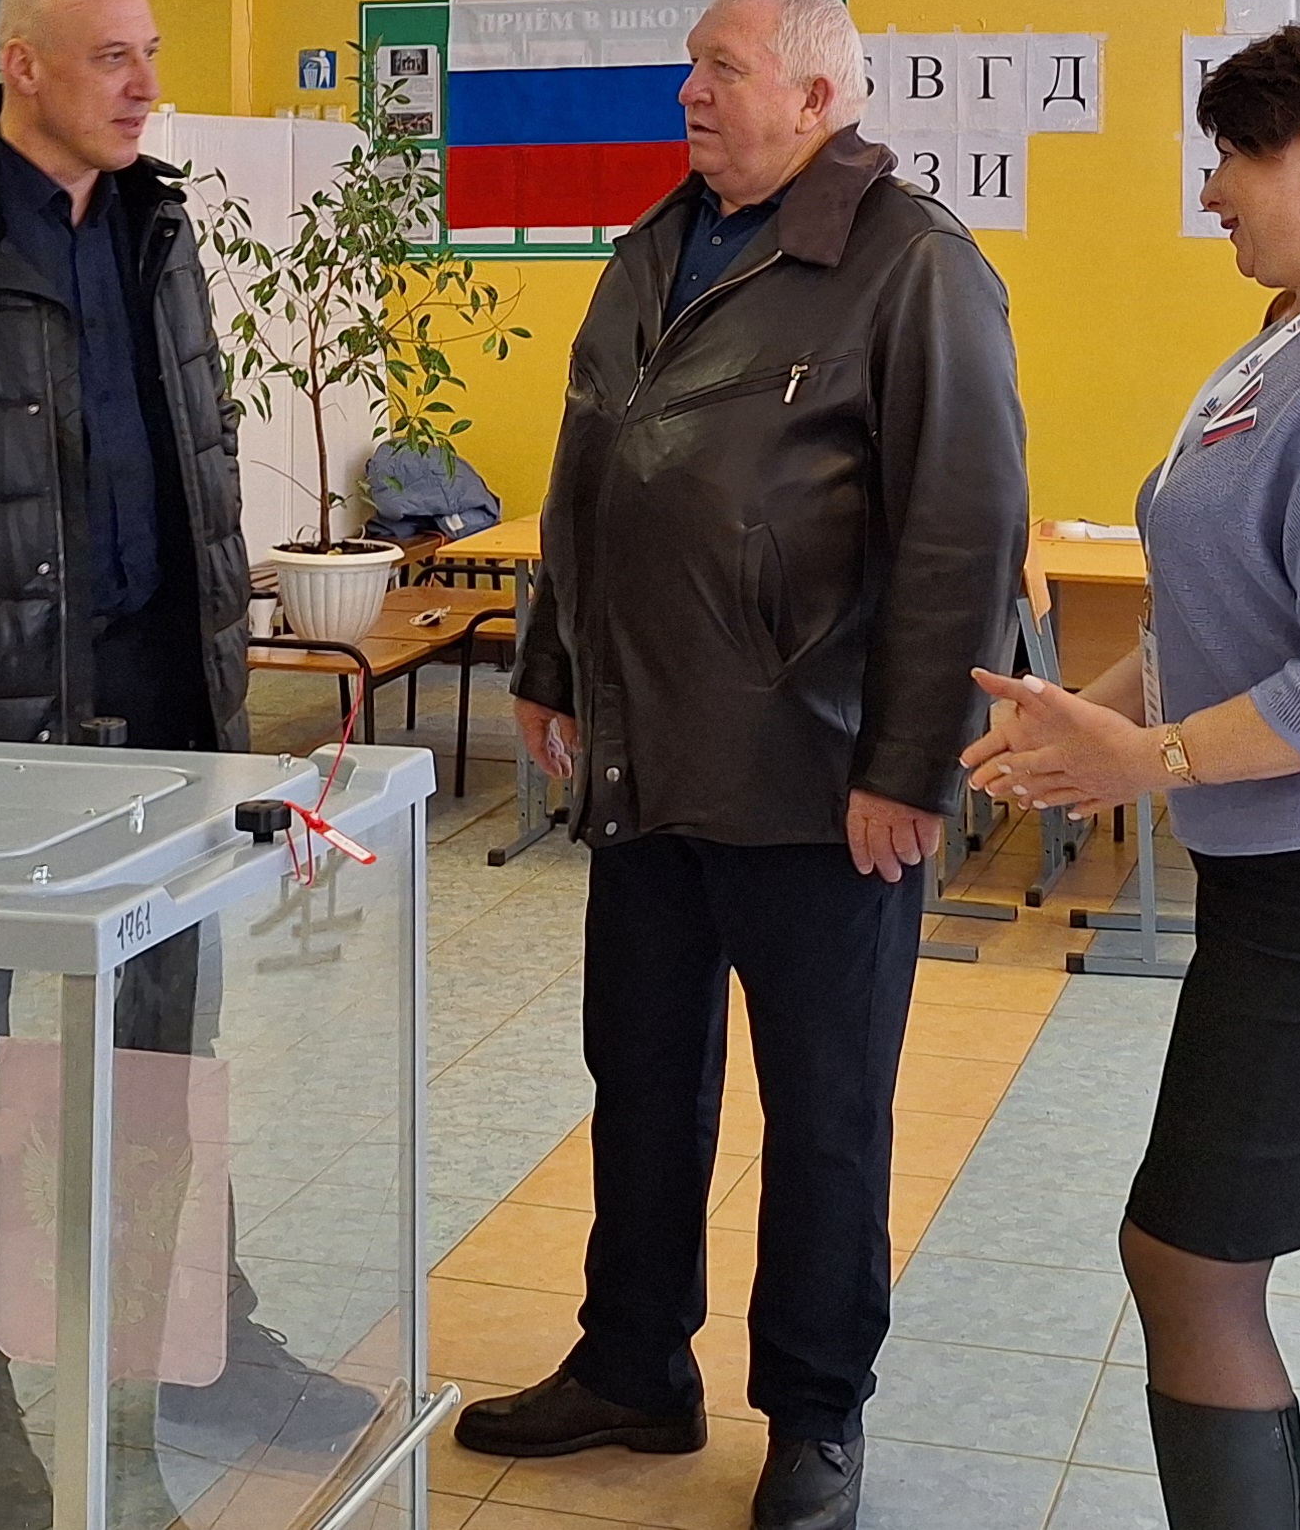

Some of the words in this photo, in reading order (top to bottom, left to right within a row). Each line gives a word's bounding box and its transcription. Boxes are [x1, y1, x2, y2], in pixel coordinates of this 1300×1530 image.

[905, 55, 944, 100] В
[976, 55, 1013, 100] Г
[1042, 55, 1087, 112] Д
[968, 153, 1013, 199] И
[116, 900, 152, 951] 1761
